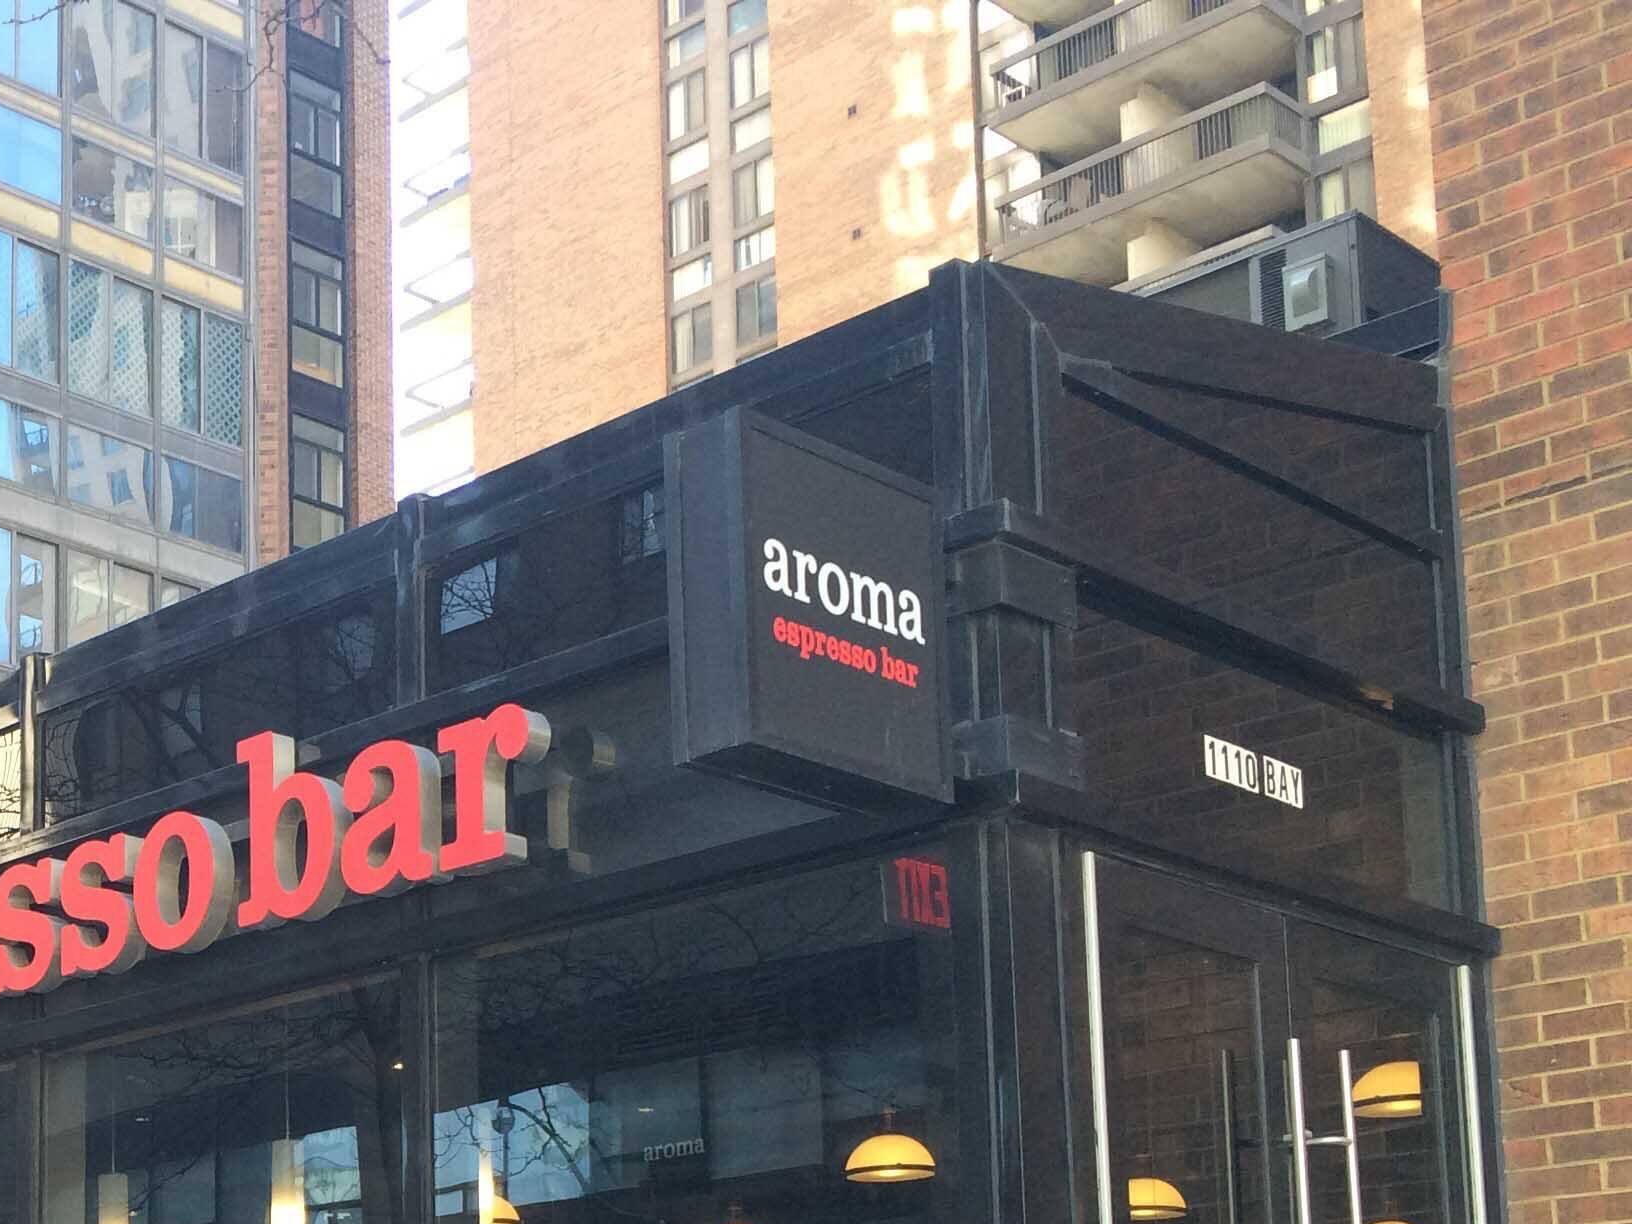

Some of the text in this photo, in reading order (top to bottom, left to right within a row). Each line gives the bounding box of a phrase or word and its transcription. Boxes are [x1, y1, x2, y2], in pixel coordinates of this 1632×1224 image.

[763, 538, 926, 646] aroma
[773, 616, 919, 688] espresso bar
[1208, 740, 1300, 805] 1110 BAY
[236, 703, 531, 928] bar
[643, 1137, 705, 1162] aroma
